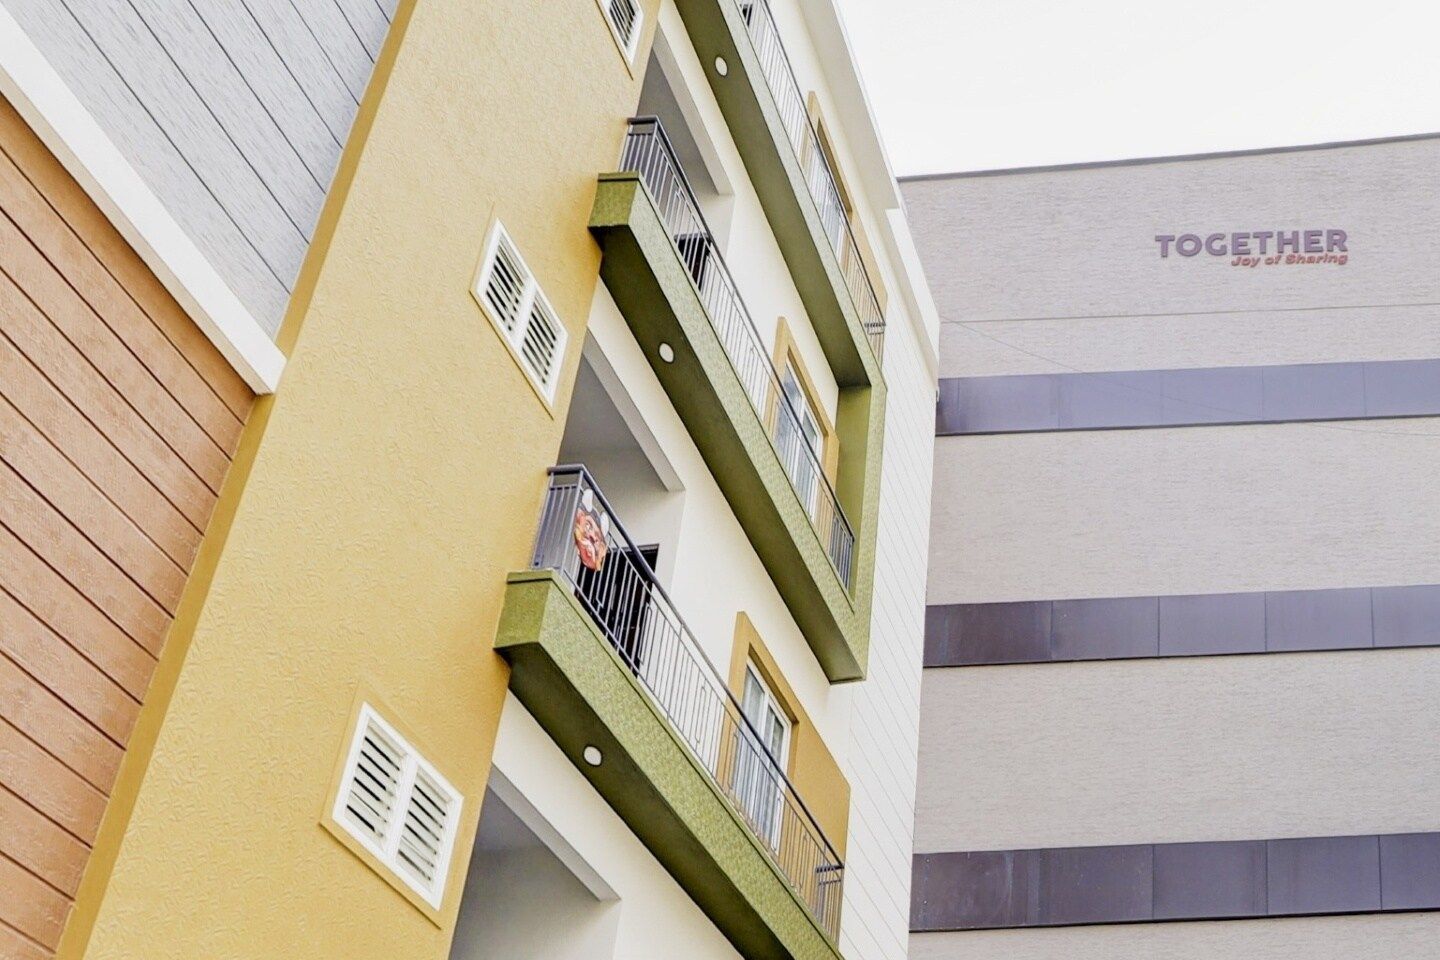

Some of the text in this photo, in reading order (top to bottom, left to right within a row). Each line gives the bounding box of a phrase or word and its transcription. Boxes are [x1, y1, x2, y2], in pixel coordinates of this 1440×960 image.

[1155, 229, 1348, 258] TOGETHER
[1231, 253, 1348, 268] Joy of Sharing
